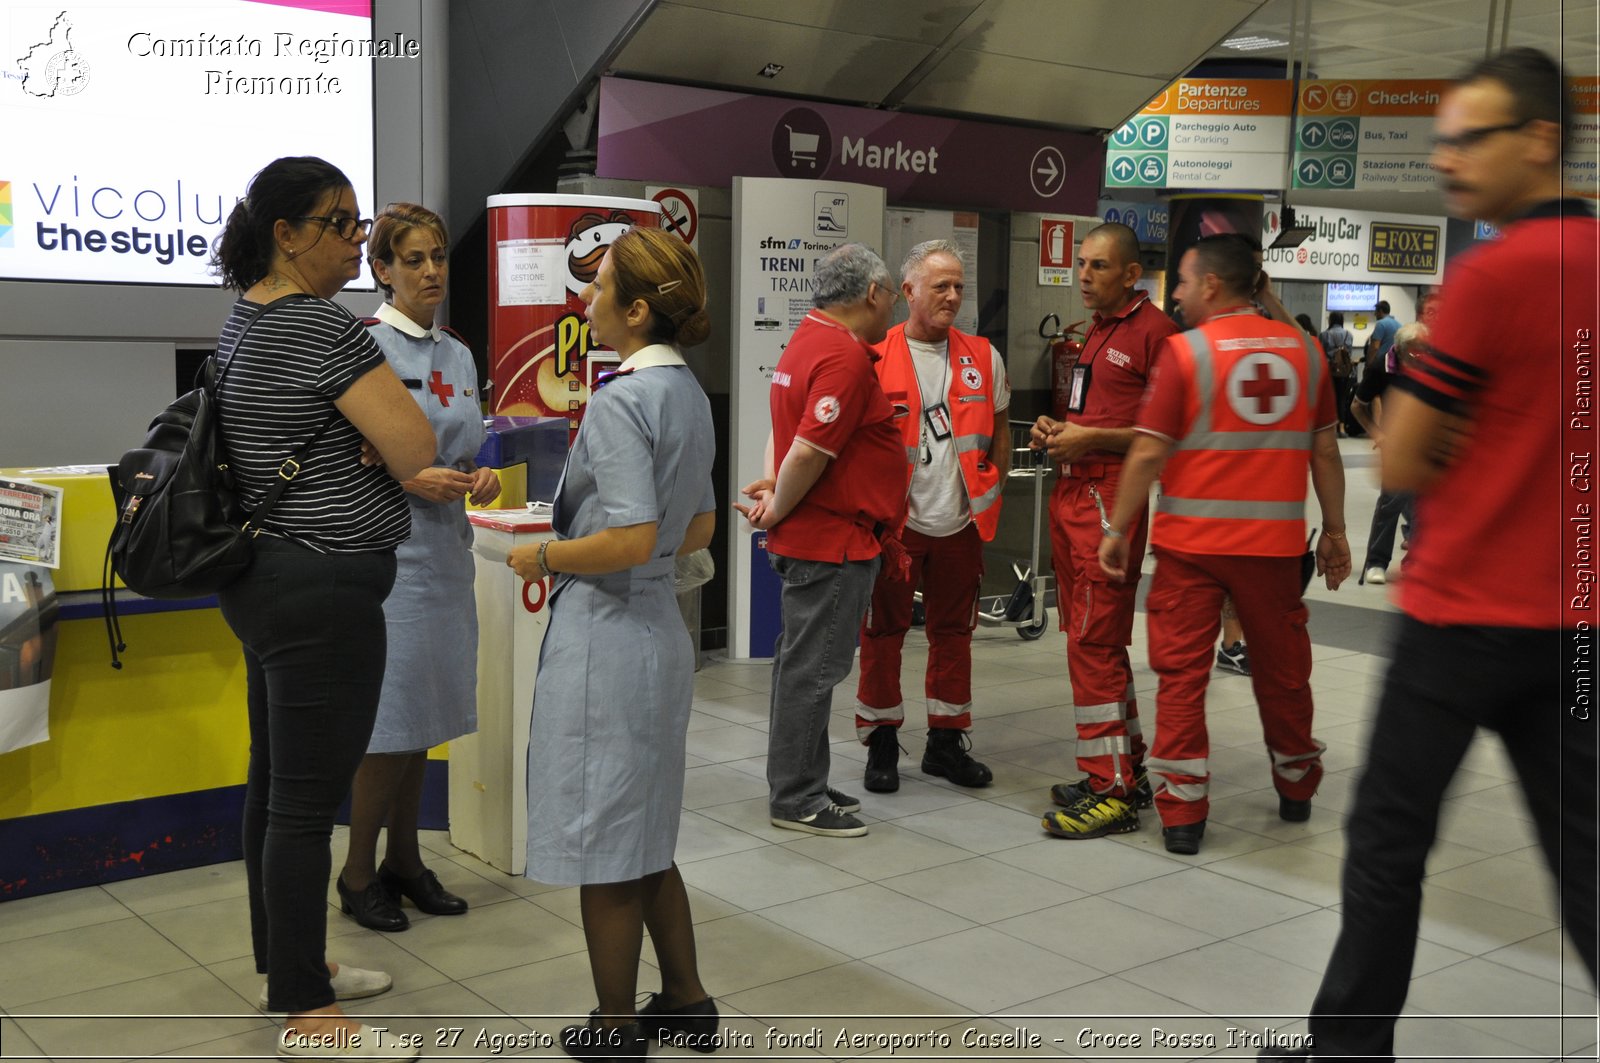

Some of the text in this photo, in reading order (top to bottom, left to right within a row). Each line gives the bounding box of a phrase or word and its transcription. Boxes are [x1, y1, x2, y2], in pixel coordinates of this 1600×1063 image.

[1178, 83, 1248, 98] Partenze
[1177, 97, 1260, 112] Departures
[1367, 90, 1440, 106] Check-in
[1175, 123, 1257, 133] Parcheggio Auto
[1174, 135, 1229, 146] Car Parking
[1364, 131, 1408, 141] Bus, Taxi
[841, 136, 939, 174] Market
[1173, 159, 1233, 170] Autonoleggi
[1362, 160, 1406, 169] Stazione
[1173, 172, 1221, 181] Rental Car
[1362, 173, 1436, 183] Railway Station
[33, 175, 241, 225] vicolu
[1338, 217, 1362, 240] Car
[760, 236, 786, 249] sfm
[1388, 231, 1422, 252] FOX
[760, 257, 805, 272] TRENI
[1310, 251, 1359, 272] europa
[1373, 252, 1433, 268] RENT A CAR
[511, 273, 545, 282] GESTIONE
[23, 510, 41, 522] ORA
